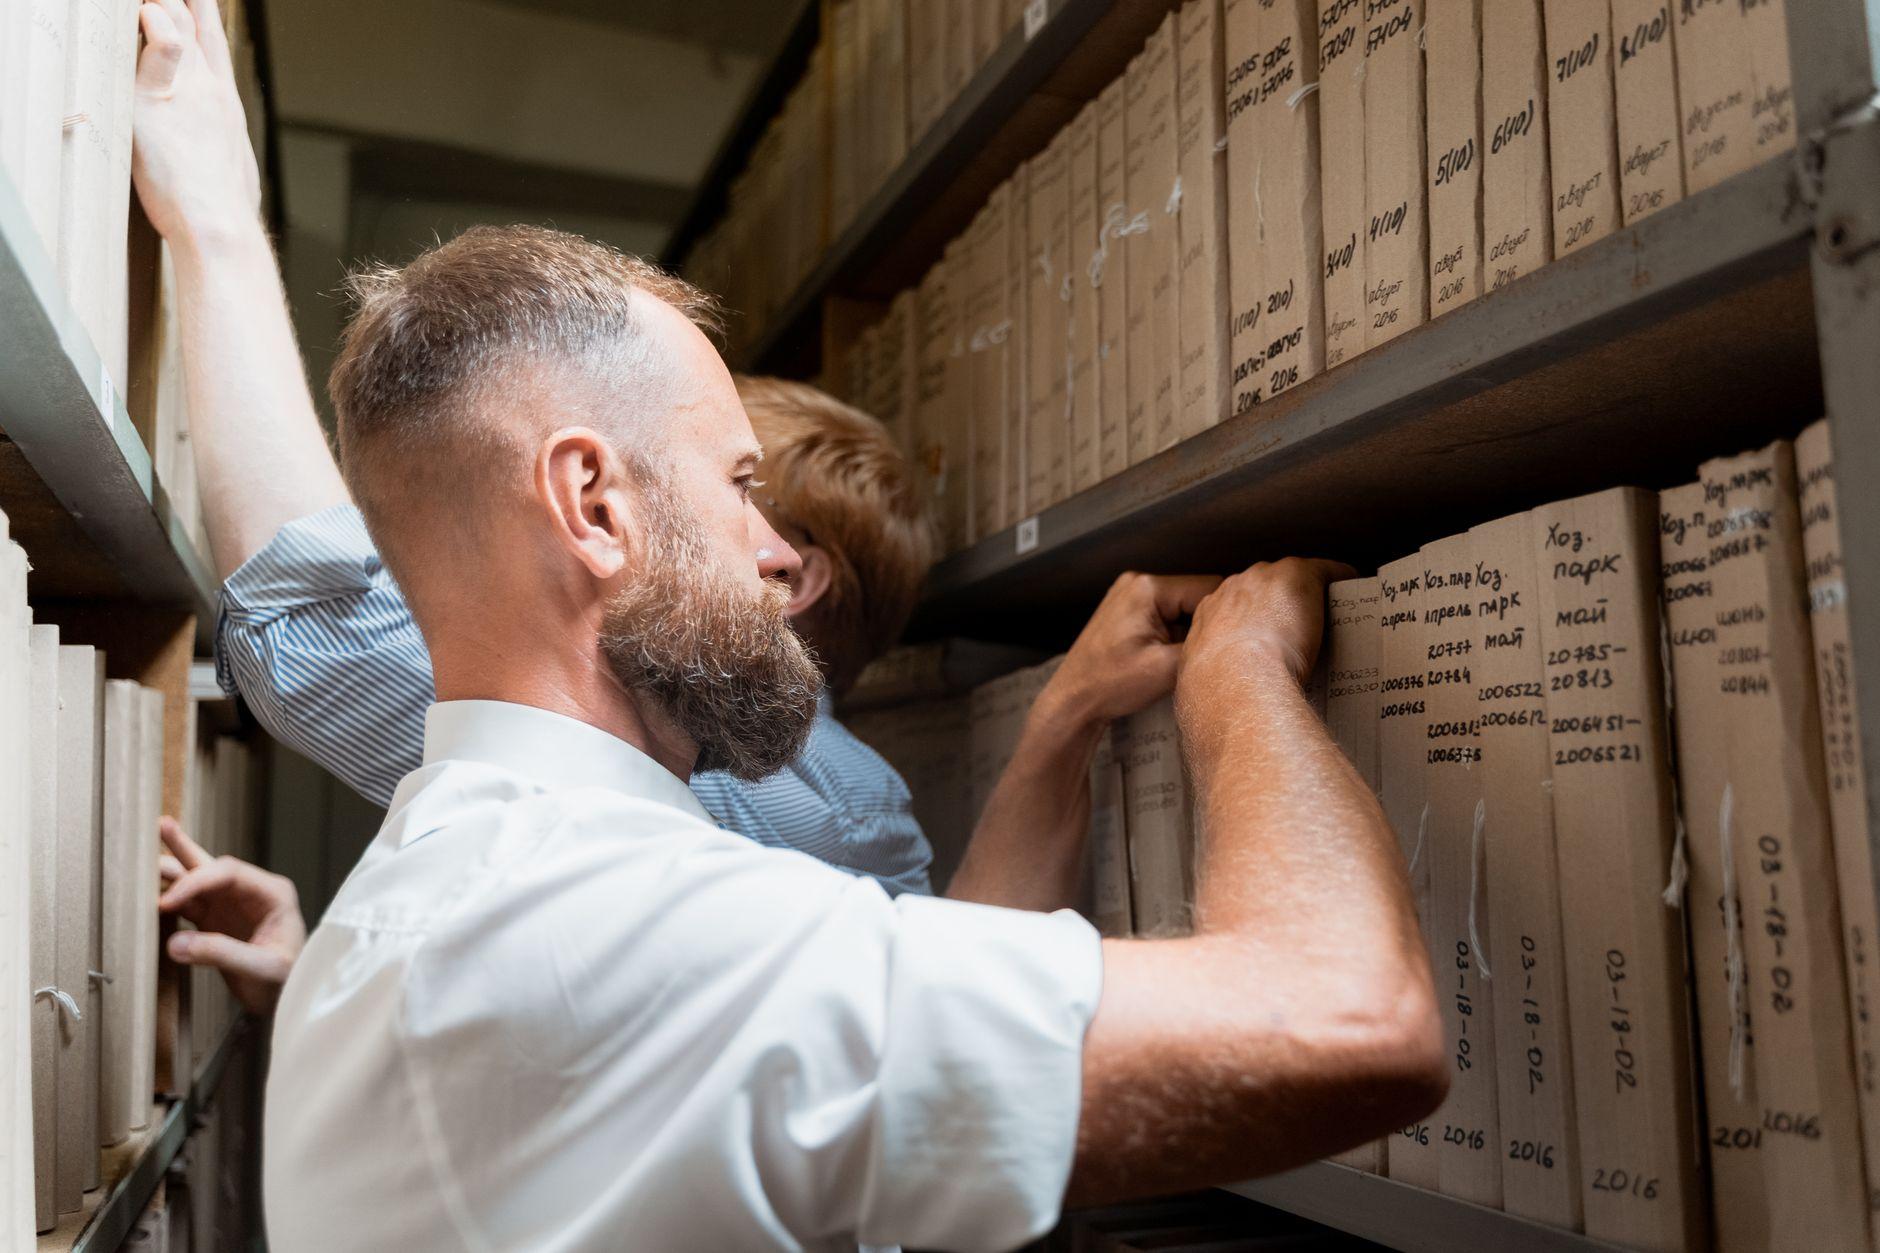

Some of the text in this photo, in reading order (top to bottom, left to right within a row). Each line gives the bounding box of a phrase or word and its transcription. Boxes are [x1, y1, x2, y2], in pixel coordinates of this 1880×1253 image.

[1320, 0, 1358, 38] 5707
[1366, 6, 1412, 57] 57104
[1320, 27, 1355, 73] 57091
[1556, 33, 1598, 82] 7(10)
[1491, 99, 1534, 154] 6(10)
[1435, 138, 1474, 186] 5(10)
[1370, 201, 1407, 242] 4(10)
[1438, 277, 1465, 303] 2016
[1373, 308, 1400, 329] 2016
[1271, 365, 1298, 394] 2016
[1237, 388, 1261, 413] 2016
[1553, 554, 1621, 586] парк
[1556, 598, 1608, 627] май
[1428, 639, 1471, 660] 20757
[1485, 627, 1525, 650] май
[1380, 673, 1424, 693] 2006376
[1427, 666, 1471, 688] 20784
[1478, 683, 1544, 701] 2006522
[1551, 668, 1613, 691] 20813
[1481, 710, 1547, 727] 2006612
[1555, 745, 1640, 766] 2006521
[1758, 835, 1793, 1015] 03-18-02
[1456, 941, 1472, 1071] 03-18-02
[1520, 935, 1544, 1095] 03-18-02
[1606, 949, 1637, 1094] 03-18-02
[1444, 1125, 1484, 1150] 2016
[1763, 1108, 1822, 1141] 2016
[1509, 1140, 1555, 1170] 2016
[1592, 1168, 1660, 1200] 2016
